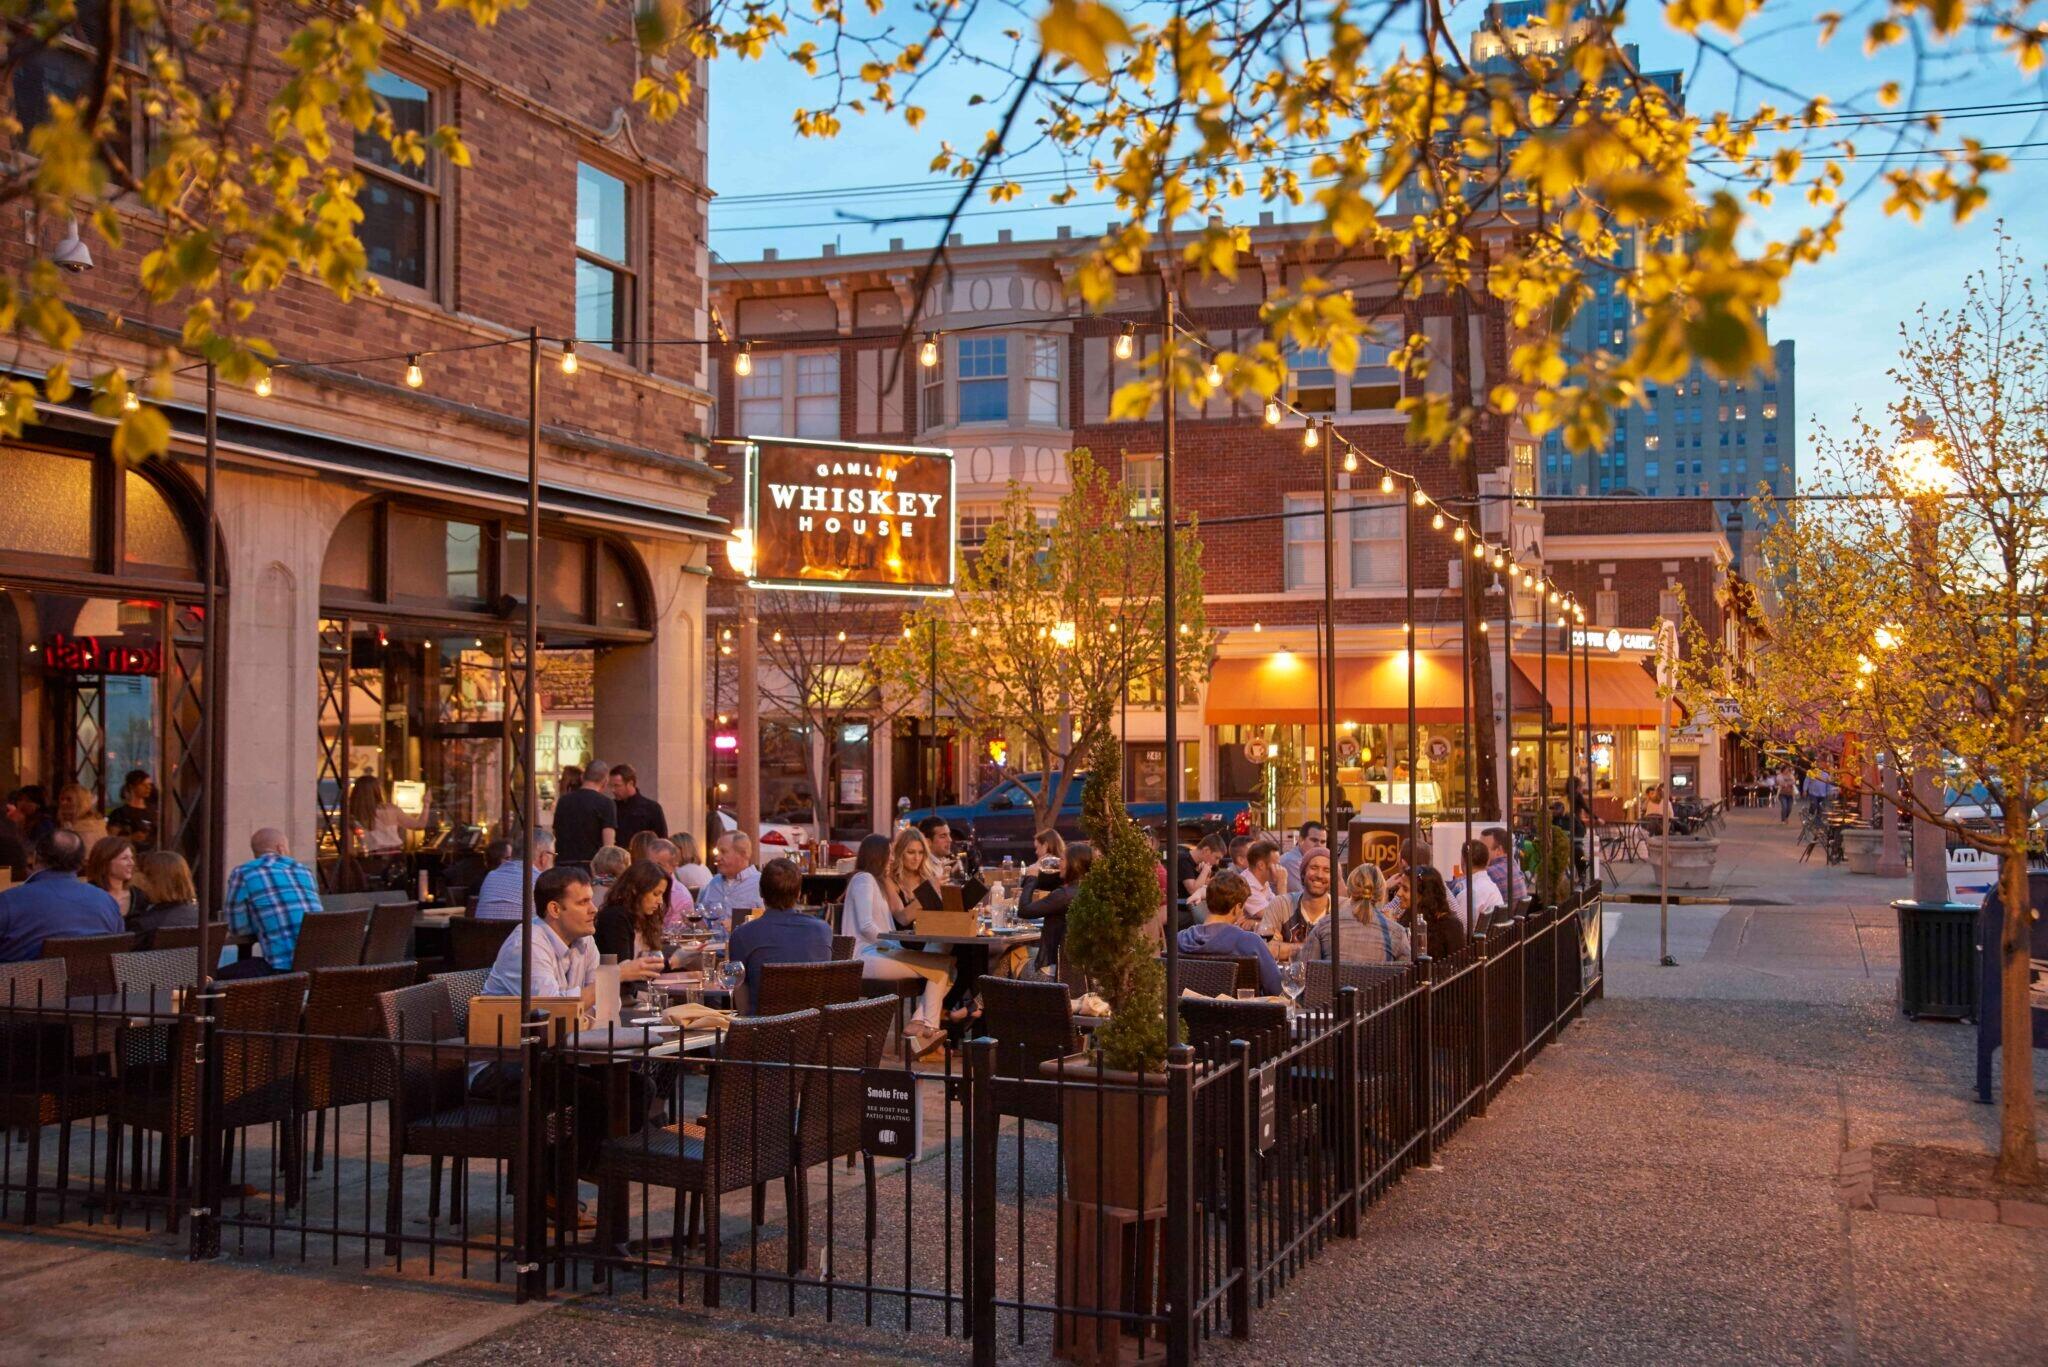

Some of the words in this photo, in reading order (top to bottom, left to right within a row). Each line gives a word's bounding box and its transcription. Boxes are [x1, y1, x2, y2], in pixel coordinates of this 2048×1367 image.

[816, 463, 898, 482] GAMLIN
[768, 484, 942, 518] WHISKEY
[799, 516, 913, 537] HOUSE
[1365, 844, 1396, 867] ups
[867, 1086, 890, 1099] Smoke
[892, 1089, 909, 1100] Free
